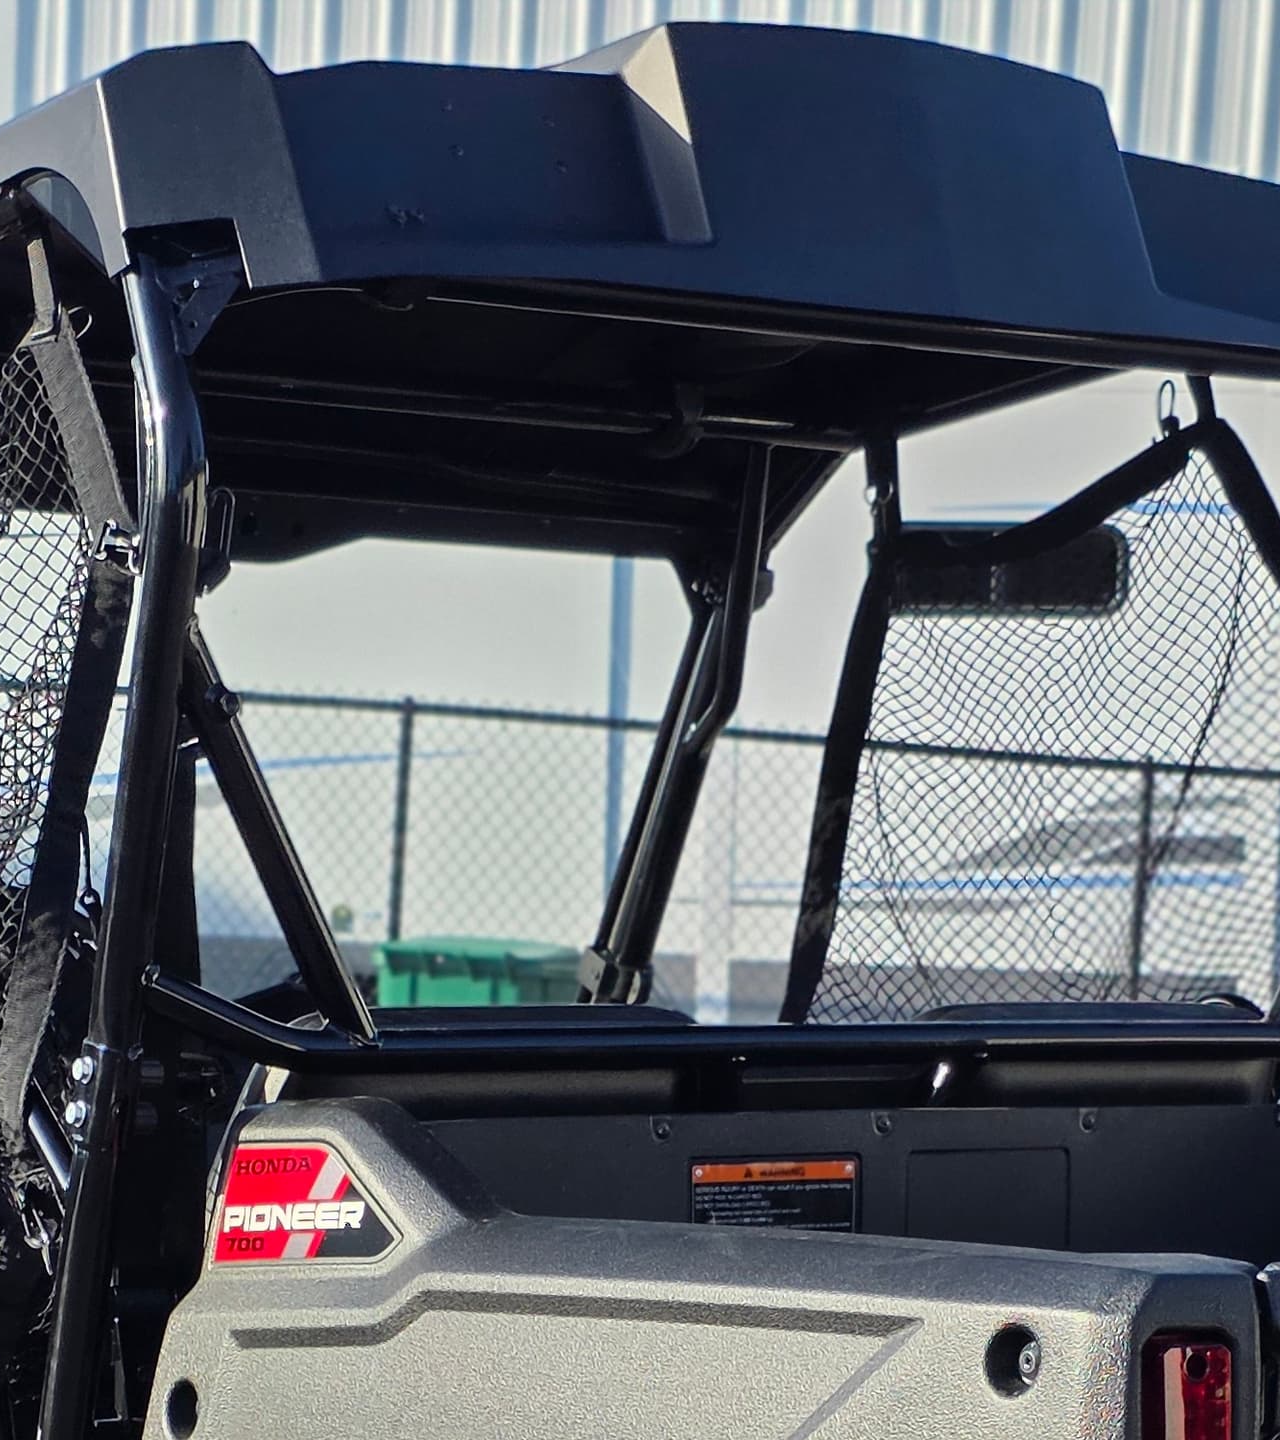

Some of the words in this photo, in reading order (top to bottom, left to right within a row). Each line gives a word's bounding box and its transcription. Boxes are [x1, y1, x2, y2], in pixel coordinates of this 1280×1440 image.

[236, 1157, 312, 1176] HONDA
[223, 1201, 366, 1233] PIONEER
[226, 1236, 265, 1252] 700
